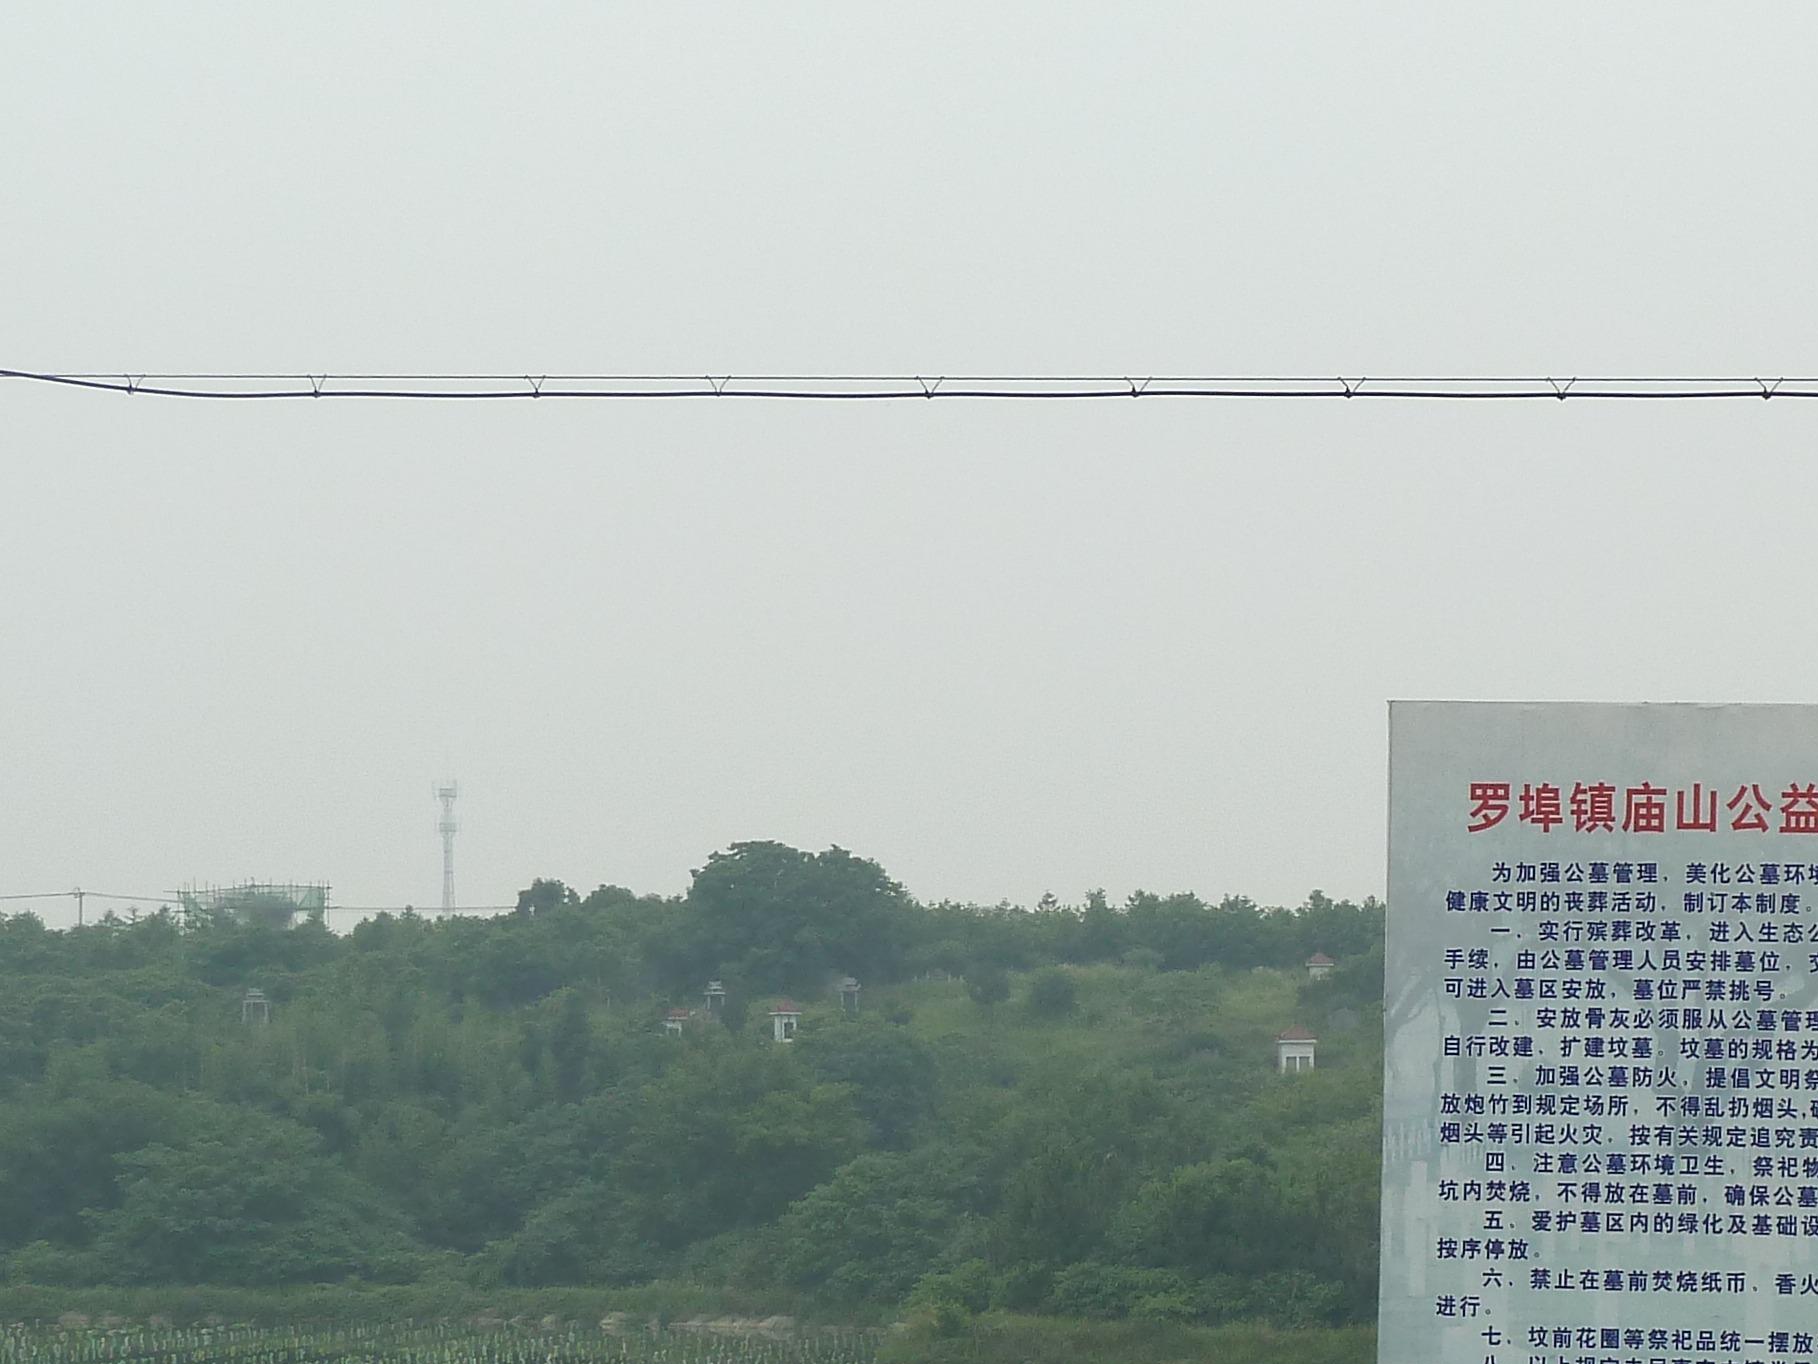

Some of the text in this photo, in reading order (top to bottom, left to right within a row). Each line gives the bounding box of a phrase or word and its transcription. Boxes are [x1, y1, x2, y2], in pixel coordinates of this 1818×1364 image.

[1436, 1236, 1540, 1261] 按序停放。
[1435, 1294, 1492, 1318] 进行。
